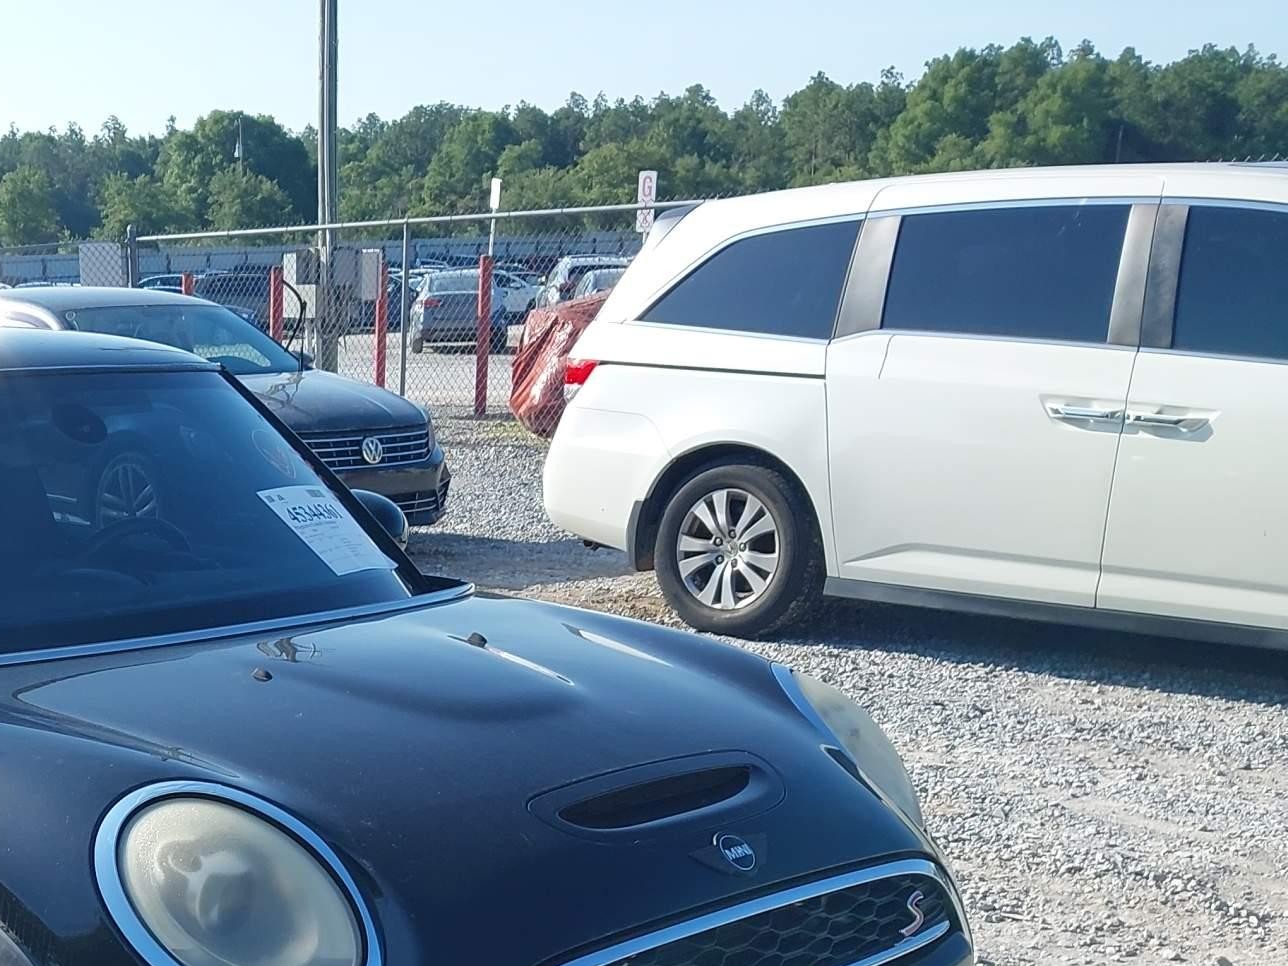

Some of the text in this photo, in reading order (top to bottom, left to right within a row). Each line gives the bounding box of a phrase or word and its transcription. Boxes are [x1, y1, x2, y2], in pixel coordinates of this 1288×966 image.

[642, 175, 653, 198] G
[286, 503, 344, 525] 45344361
[724, 843, 753, 861] MINI
[898, 890, 924, 937] S
